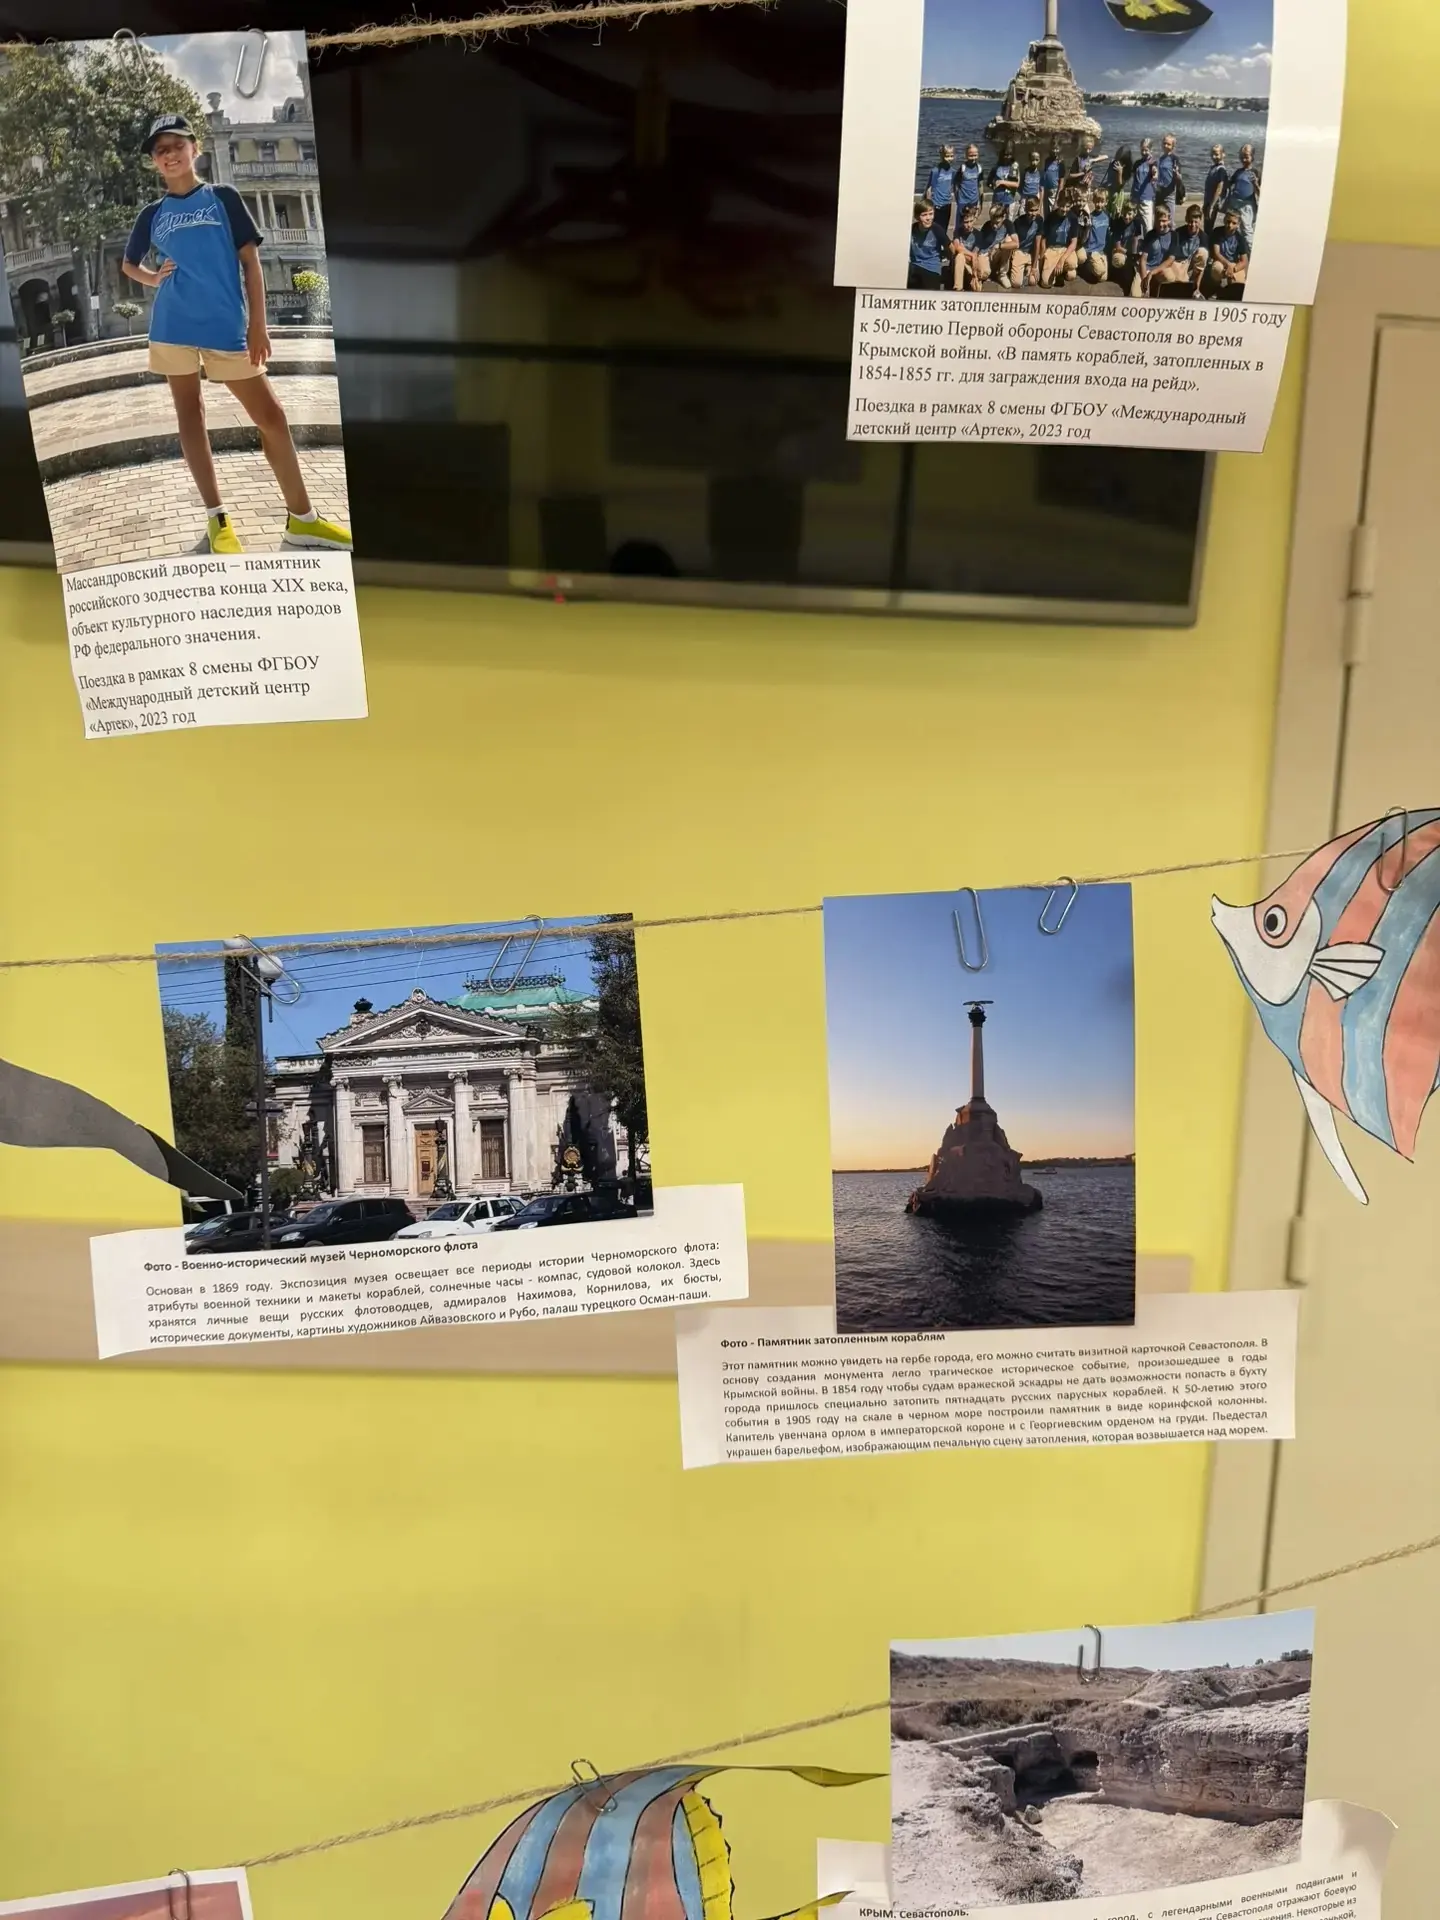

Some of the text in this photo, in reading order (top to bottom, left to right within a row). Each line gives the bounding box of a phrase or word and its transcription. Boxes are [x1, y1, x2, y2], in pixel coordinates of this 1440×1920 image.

[861, 293, 1287, 328] Памятник затопленным кораблям сооружён в 1905 году
[860, 318, 1243, 349] к 50-летию Первой обороны Севастополя во время
[858, 341, 1264, 371] Крымской войны. «В память кораблей, затопленных в
[859, 364, 1199, 392] 1854-1855 гг. для заграждения входа на рейд».
[855, 397, 1246, 425] Поездка в рамках 8 смены ФГБОУ «Международный
[852, 422, 1091, 439] детский центр «Артек», 2023 год
[66, 558, 321, 592] Массандровский дворец памятник
[69, 578, 348, 618] российского зодчества конца XIX века,
[71, 604, 341, 637] объект культурного наследия народов
[74, 629, 260, 659] РФ федерального значения.
[79, 655, 318, 689] Поездка в рамках 8 смены ФГБОУ
[85, 681, 310, 710] «Международный детский центр
[89, 710, 197, 735] «Артек», 2023 год
[143, 1241, 478, 1271] Фото Военно-исторический музей Черноморского флота
[145, 1242, 719, 1296] Основан в 1869 году. Экспозиция музея освещает все периоды истории Черноморского флота:
[147, 1258, 720, 1313] атрибуты военной техники макеты кораблей, солнечные часы компас, судовой колокол. Здесь
[148, 1273, 721, 1329] хранятся личные вещи русских флотоводцев, адмиралов Нахимова, Корнилова, их бюсты,
[150, 1290, 710, 1344] исторические документы, картины художников Айвазовского Рубо, палаш турецкого Осман-паши.
[720, 1330, 945, 1348] Фото Памятник затопленным кораблям
[722, 1354, 1267, 1385] основу создания монумента легло трагическое историческое событие, произошедшее в годы
[726, 1426, 1268, 1459] украшен барельефом, изображающим печальную сцену затопления, которая возвышается над морем.
[1161, 1874, 1343, 1917] легендарными военными подвигами
[1276, 1892, 1320, 1908] отражают
[1323, 1884, 1357, 1898] боевую
[1296, 1900, 1345, 1917] Некоторые
[1346, 1897, 1357, 1905] из
[860, 1908, 896, 1918] КРЫМ.
